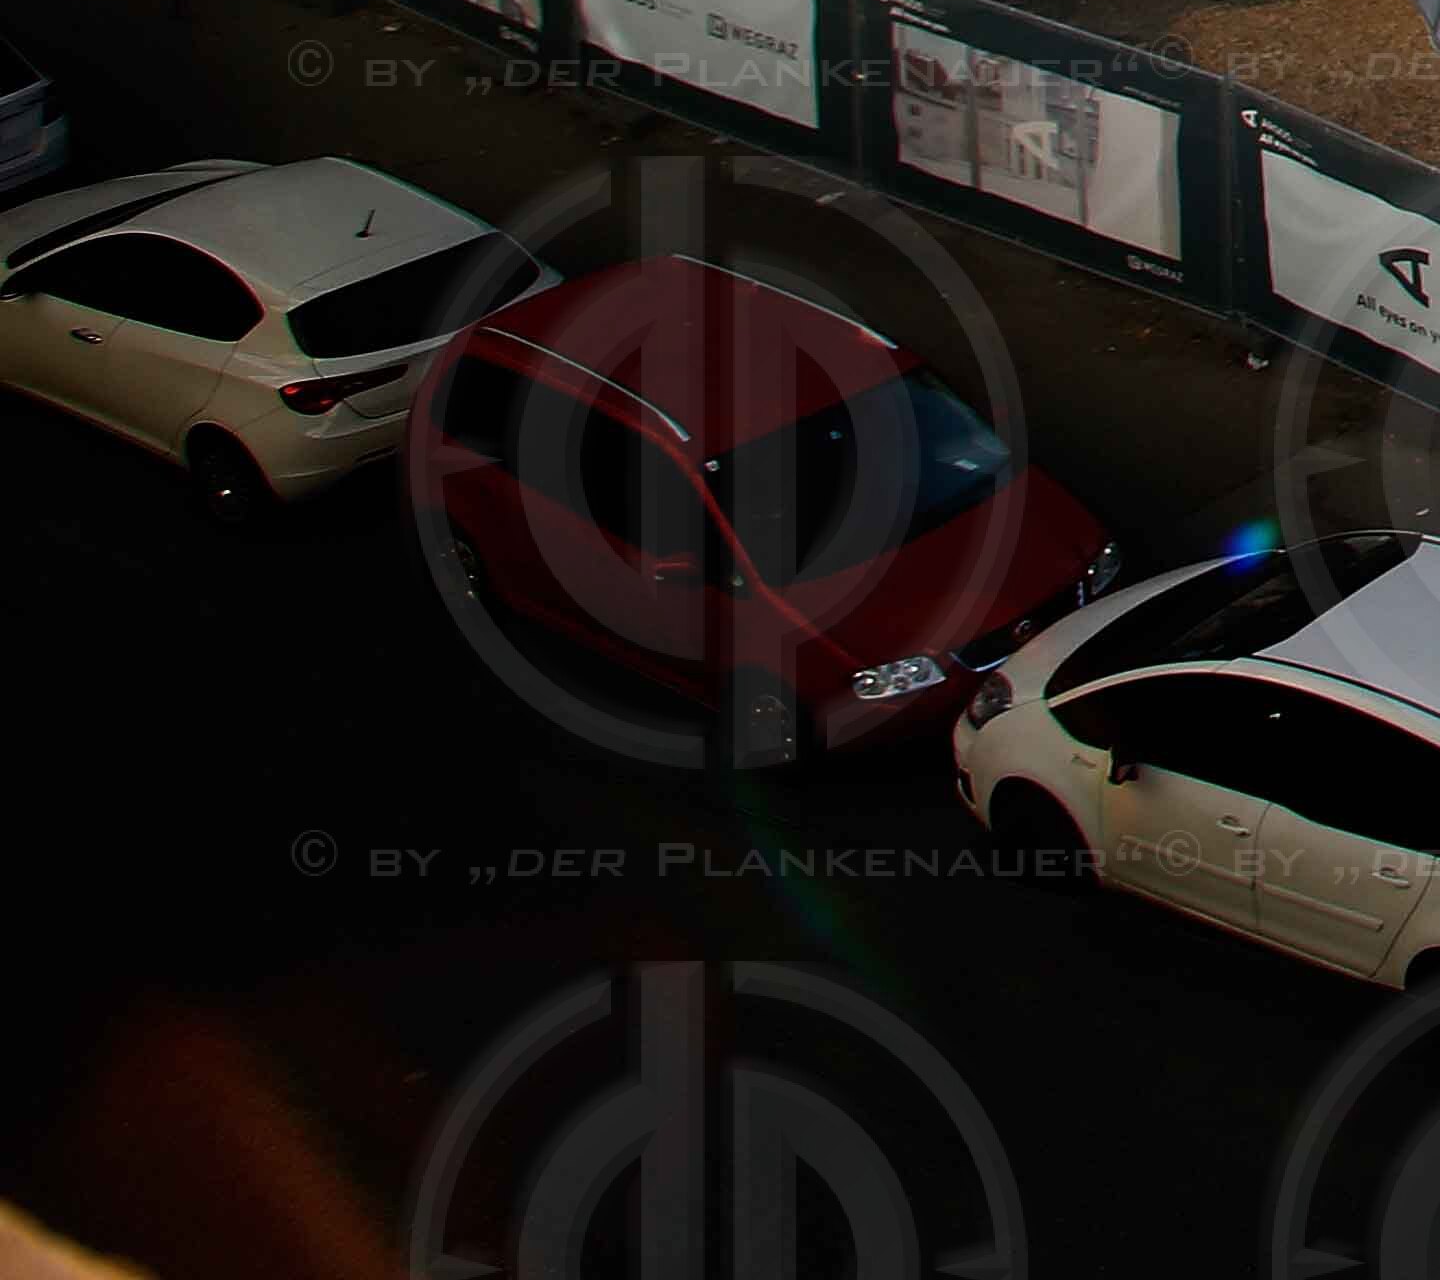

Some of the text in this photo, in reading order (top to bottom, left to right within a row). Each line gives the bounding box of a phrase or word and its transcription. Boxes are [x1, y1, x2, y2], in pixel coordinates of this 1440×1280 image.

[1356, 293, 1377, 312] All
[1378, 305, 1408, 329] eyes
[1408, 321, 1428, 337] on
